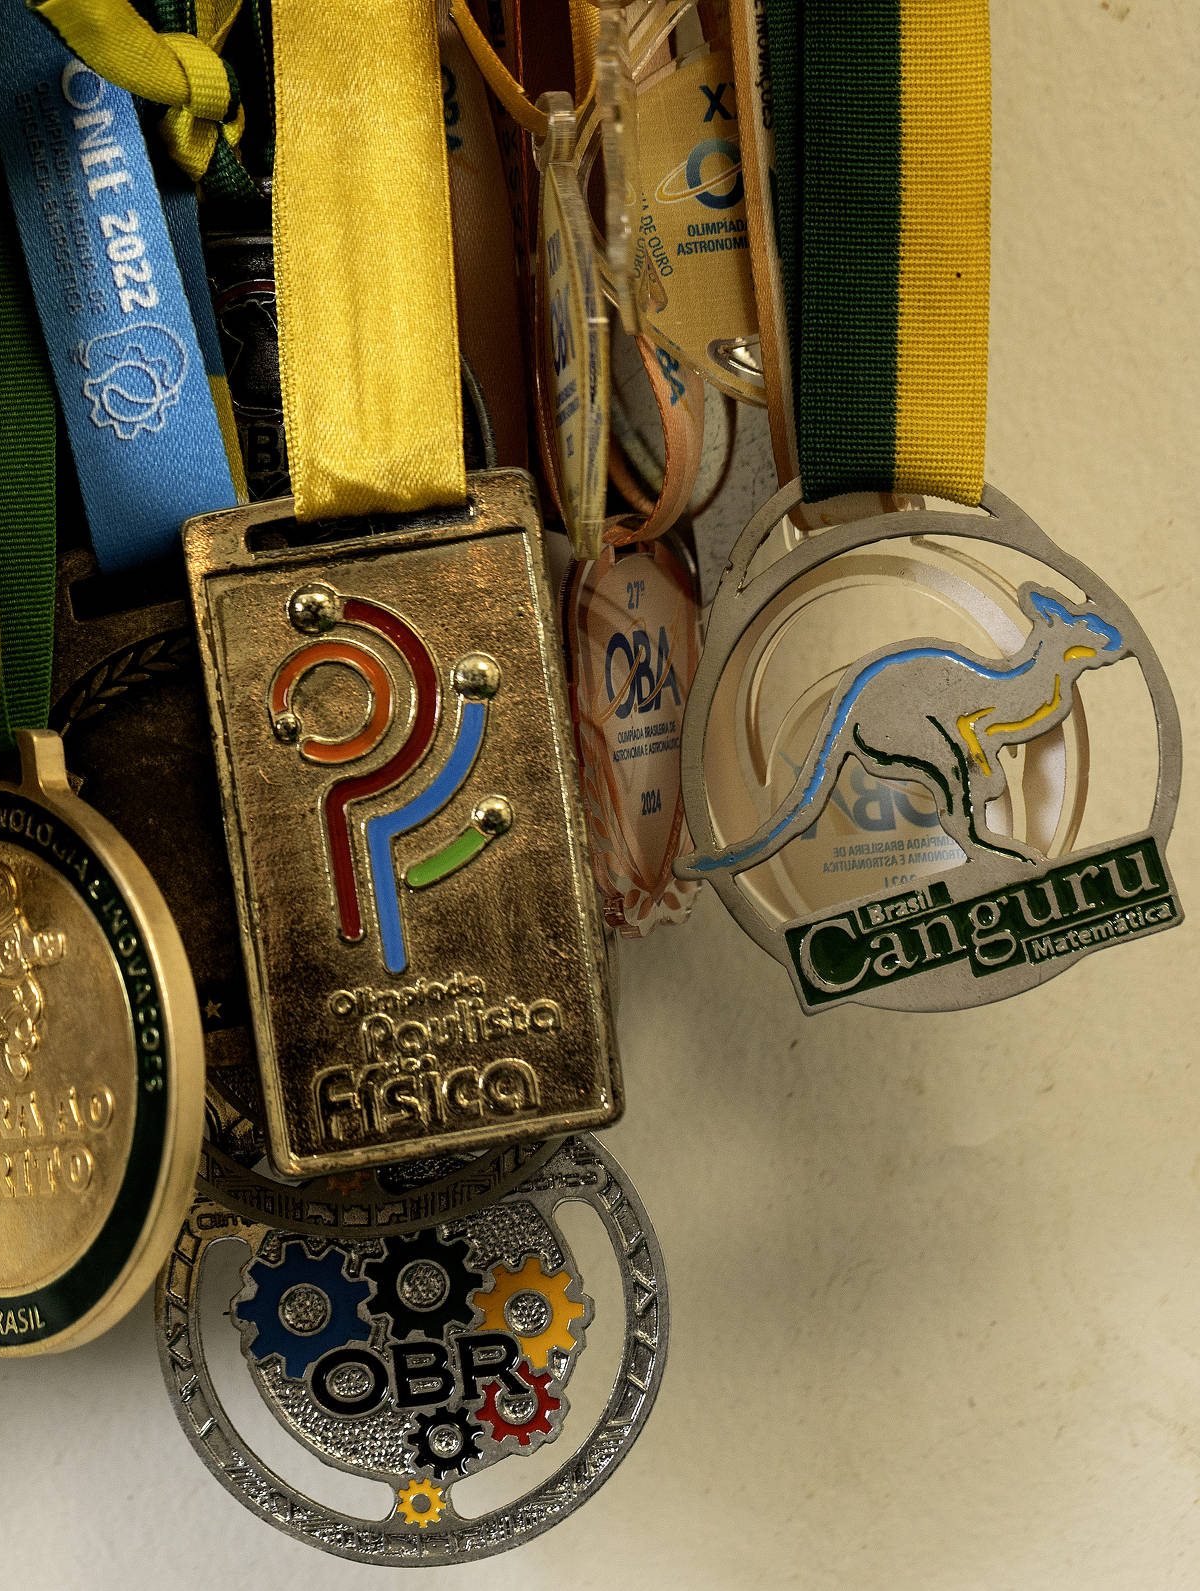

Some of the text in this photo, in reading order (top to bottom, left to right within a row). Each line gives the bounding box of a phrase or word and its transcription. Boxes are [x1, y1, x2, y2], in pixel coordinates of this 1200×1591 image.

[62, 60, 160, 315] ONEE 2022
[687, 216, 749, 239] OLIMPÍAD
[648, 236, 674, 278] OURO
[676, 237, 751, 256] ASTRONOMI
[605, 626, 681, 720] OBA
[618, 725, 644, 745] OLIMPÍADA
[648, 737, 681, 758] ASTRONÁUTIC
[641, 789, 662, 816] 2024
[800, 848, 1162, 993] Canguru
[869, 894, 935, 926] Brasil
[1031, 904, 1173, 961] Matemática
[310, 1328, 534, 1418] OBR
